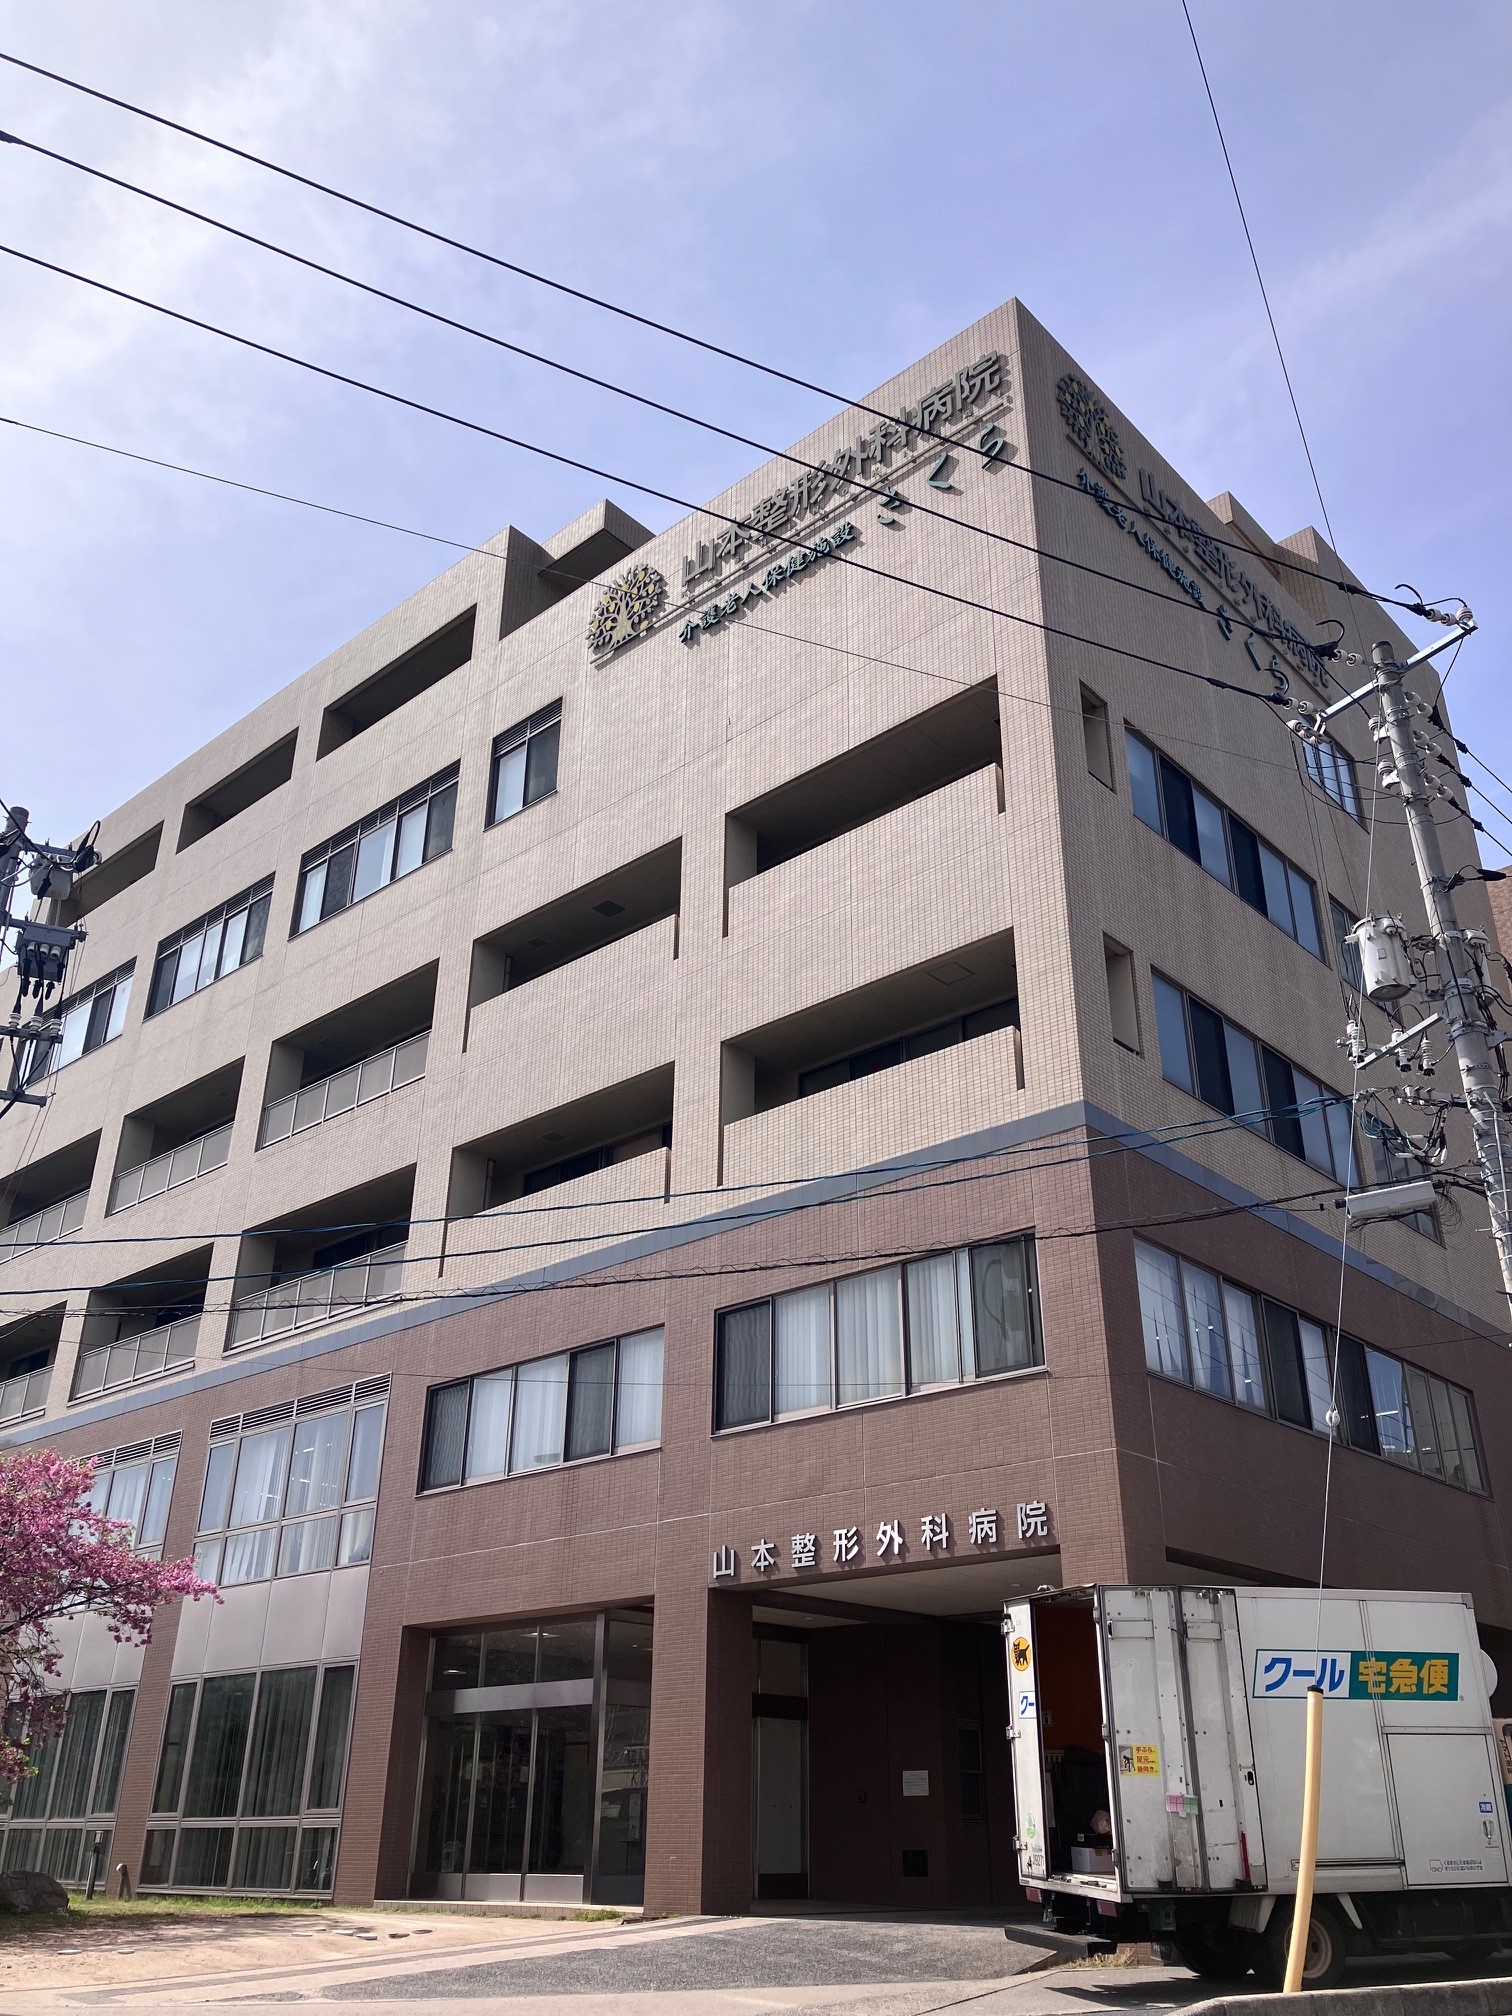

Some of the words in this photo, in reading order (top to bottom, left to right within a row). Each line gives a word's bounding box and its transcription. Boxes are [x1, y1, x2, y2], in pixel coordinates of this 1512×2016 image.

[678, 521, 857, 643] 介護老人保健施設
[876, 421, 1005, 524] さくら
[681, 349, 1001, 588] 山本整形外科病院
[712, 1500, 1049, 1579] 山本整形外科病院
[1263, 1657, 1346, 1693] クール
[1357, 1657, 1450, 1695] 宅急便
